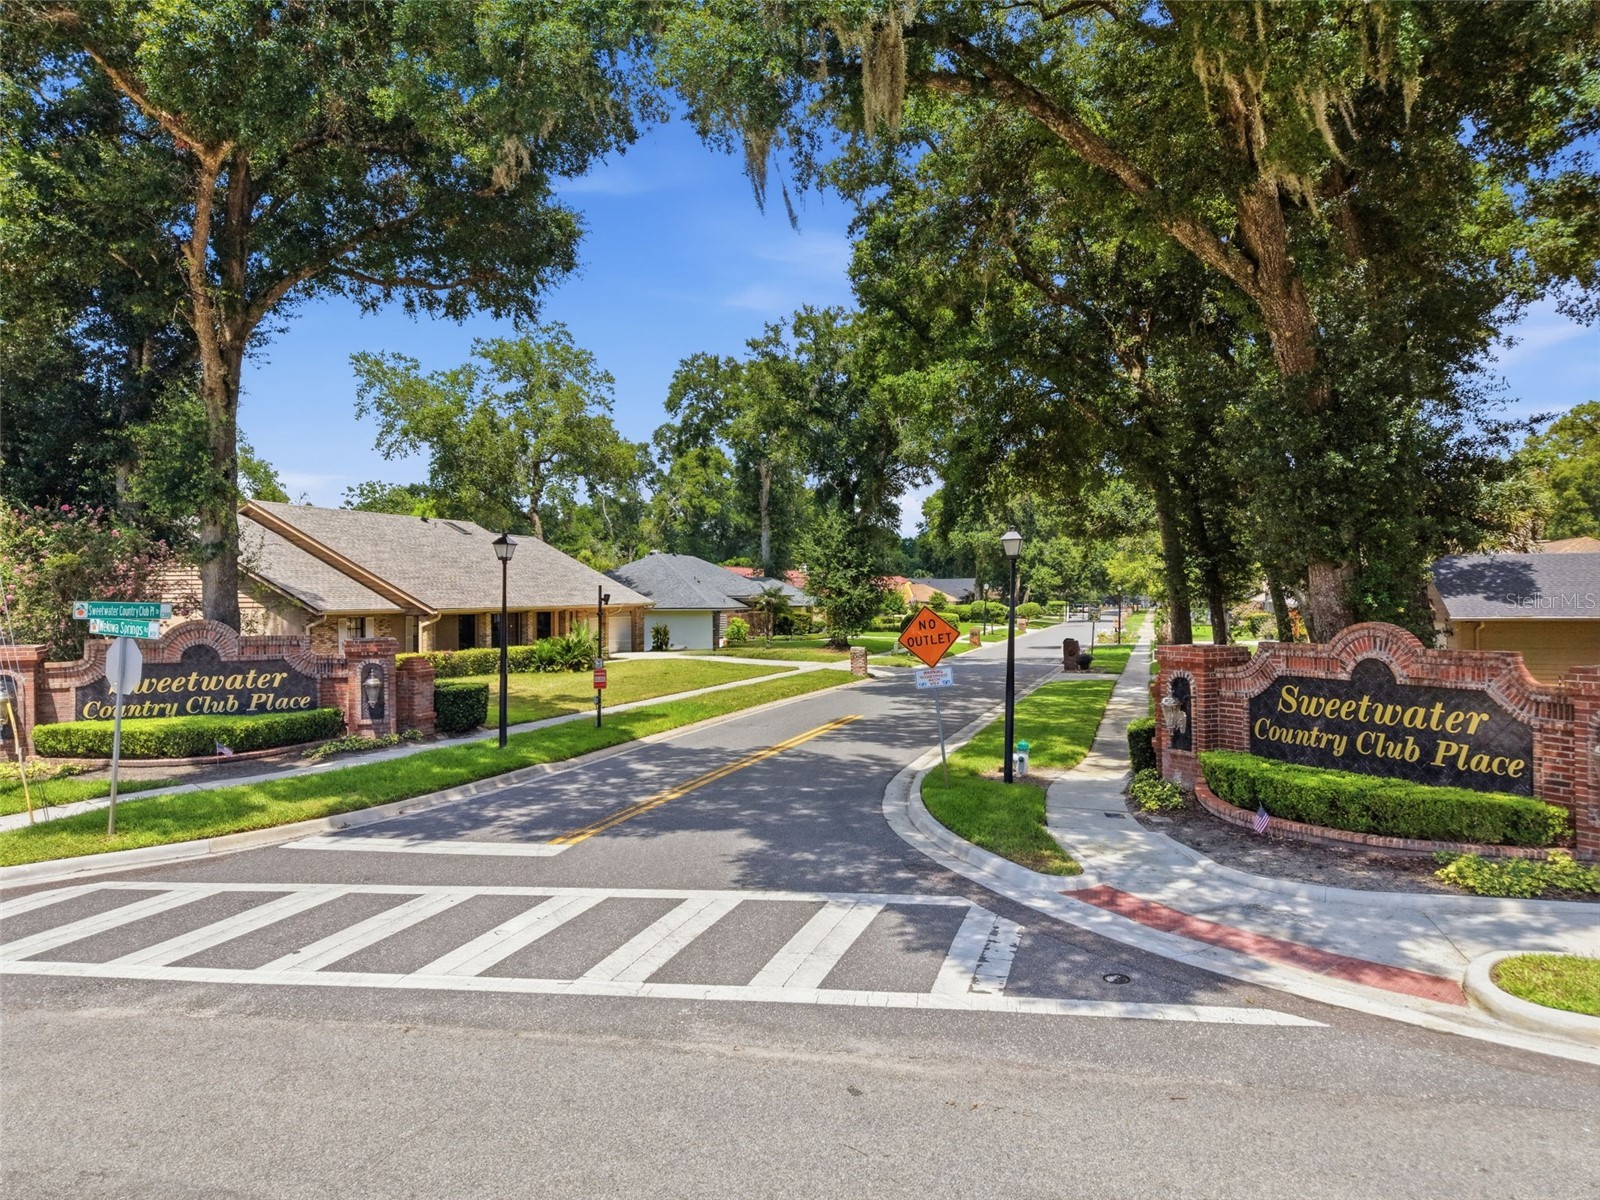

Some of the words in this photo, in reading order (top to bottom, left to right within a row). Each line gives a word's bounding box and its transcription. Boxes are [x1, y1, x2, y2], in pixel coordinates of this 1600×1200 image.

[88, 605, 119, 616] Sweetwater
[119, 605, 138, 618] Country
[139, 606, 149, 616] Club
[120, 622, 143, 637] Springs
[918, 619, 936, 630] NO
[907, 632, 952, 648] OUTLET
[109, 669, 288, 695] weetwater
[186, 696, 238, 714] Club
[246, 693, 311, 711] Place
[1277, 685, 1490, 735] Sweetwater
[1254, 717, 1348, 757] Country
[1356, 731, 1421, 763] Club
[1430, 740, 1526, 778] Place
